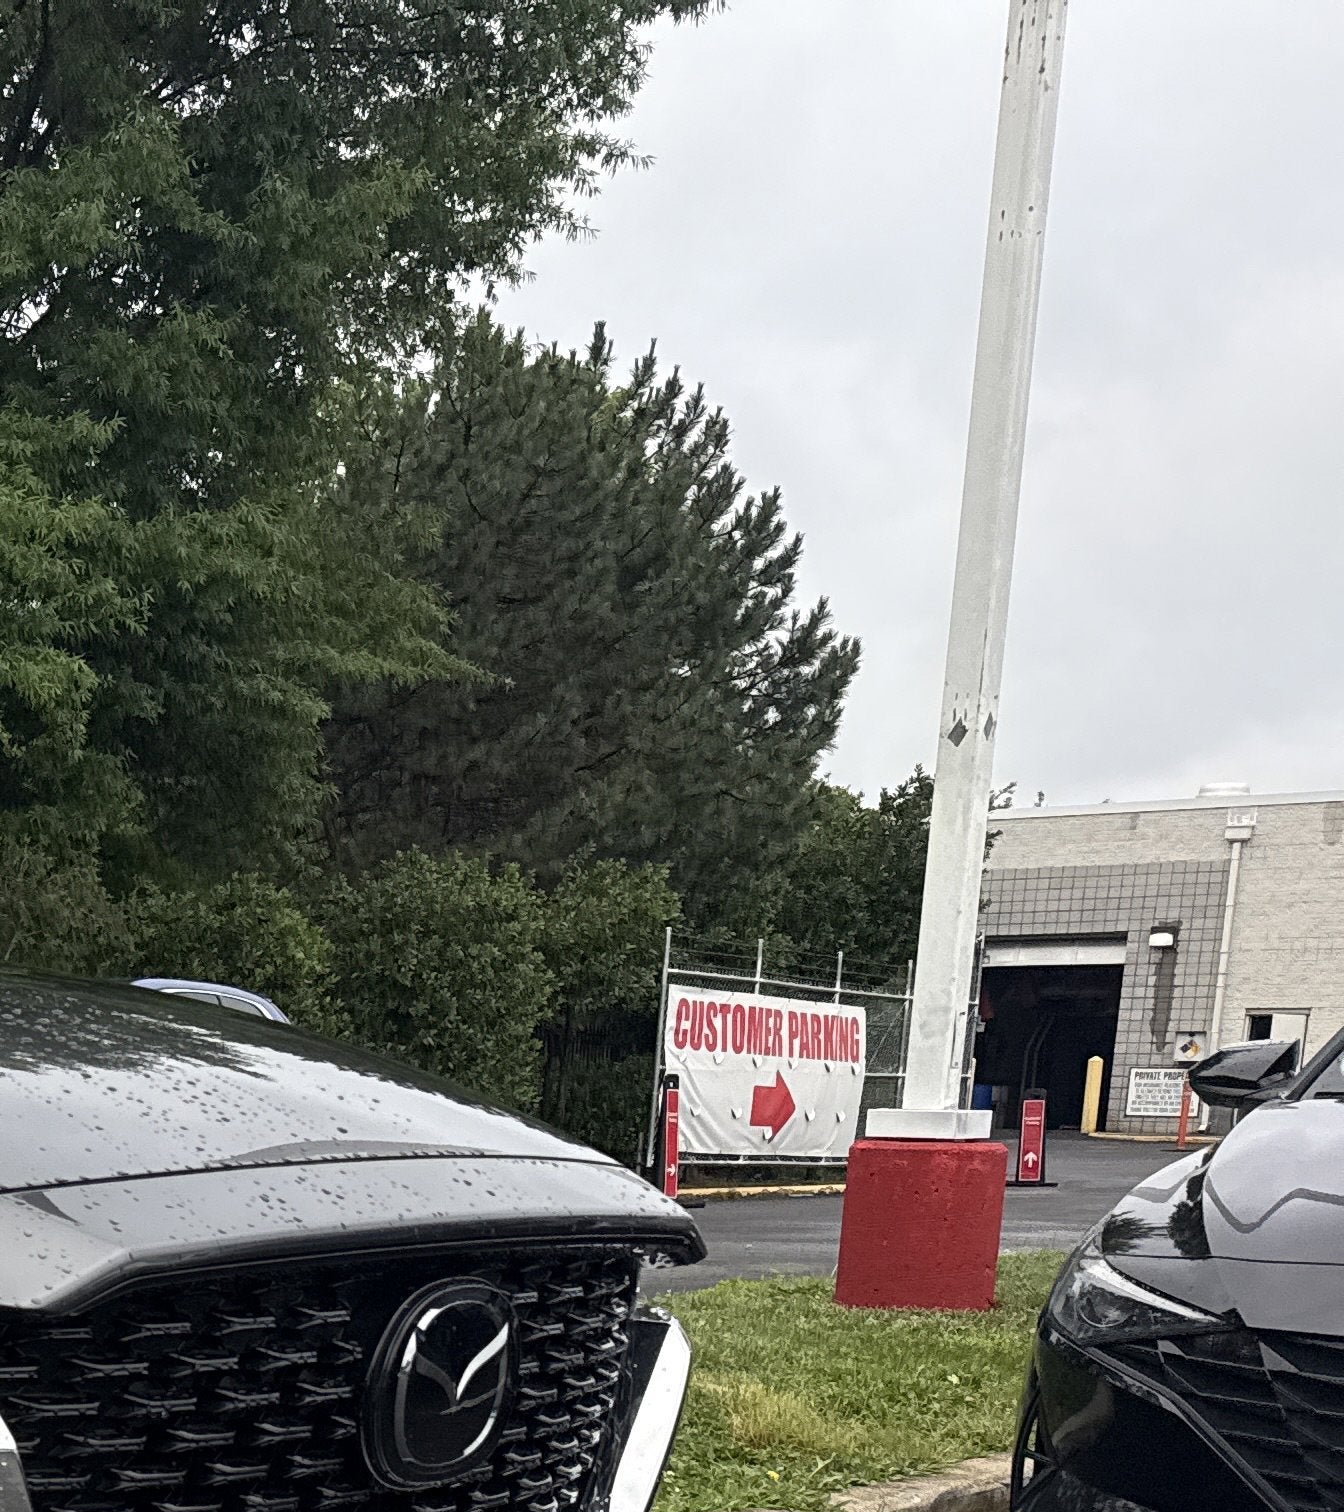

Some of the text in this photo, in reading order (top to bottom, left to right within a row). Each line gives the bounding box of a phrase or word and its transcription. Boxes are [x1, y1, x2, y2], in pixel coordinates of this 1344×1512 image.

[673, 997, 860, 1064] CUSTOMER PARKING
[1134, 1071, 1161, 1080] PRIVATE
